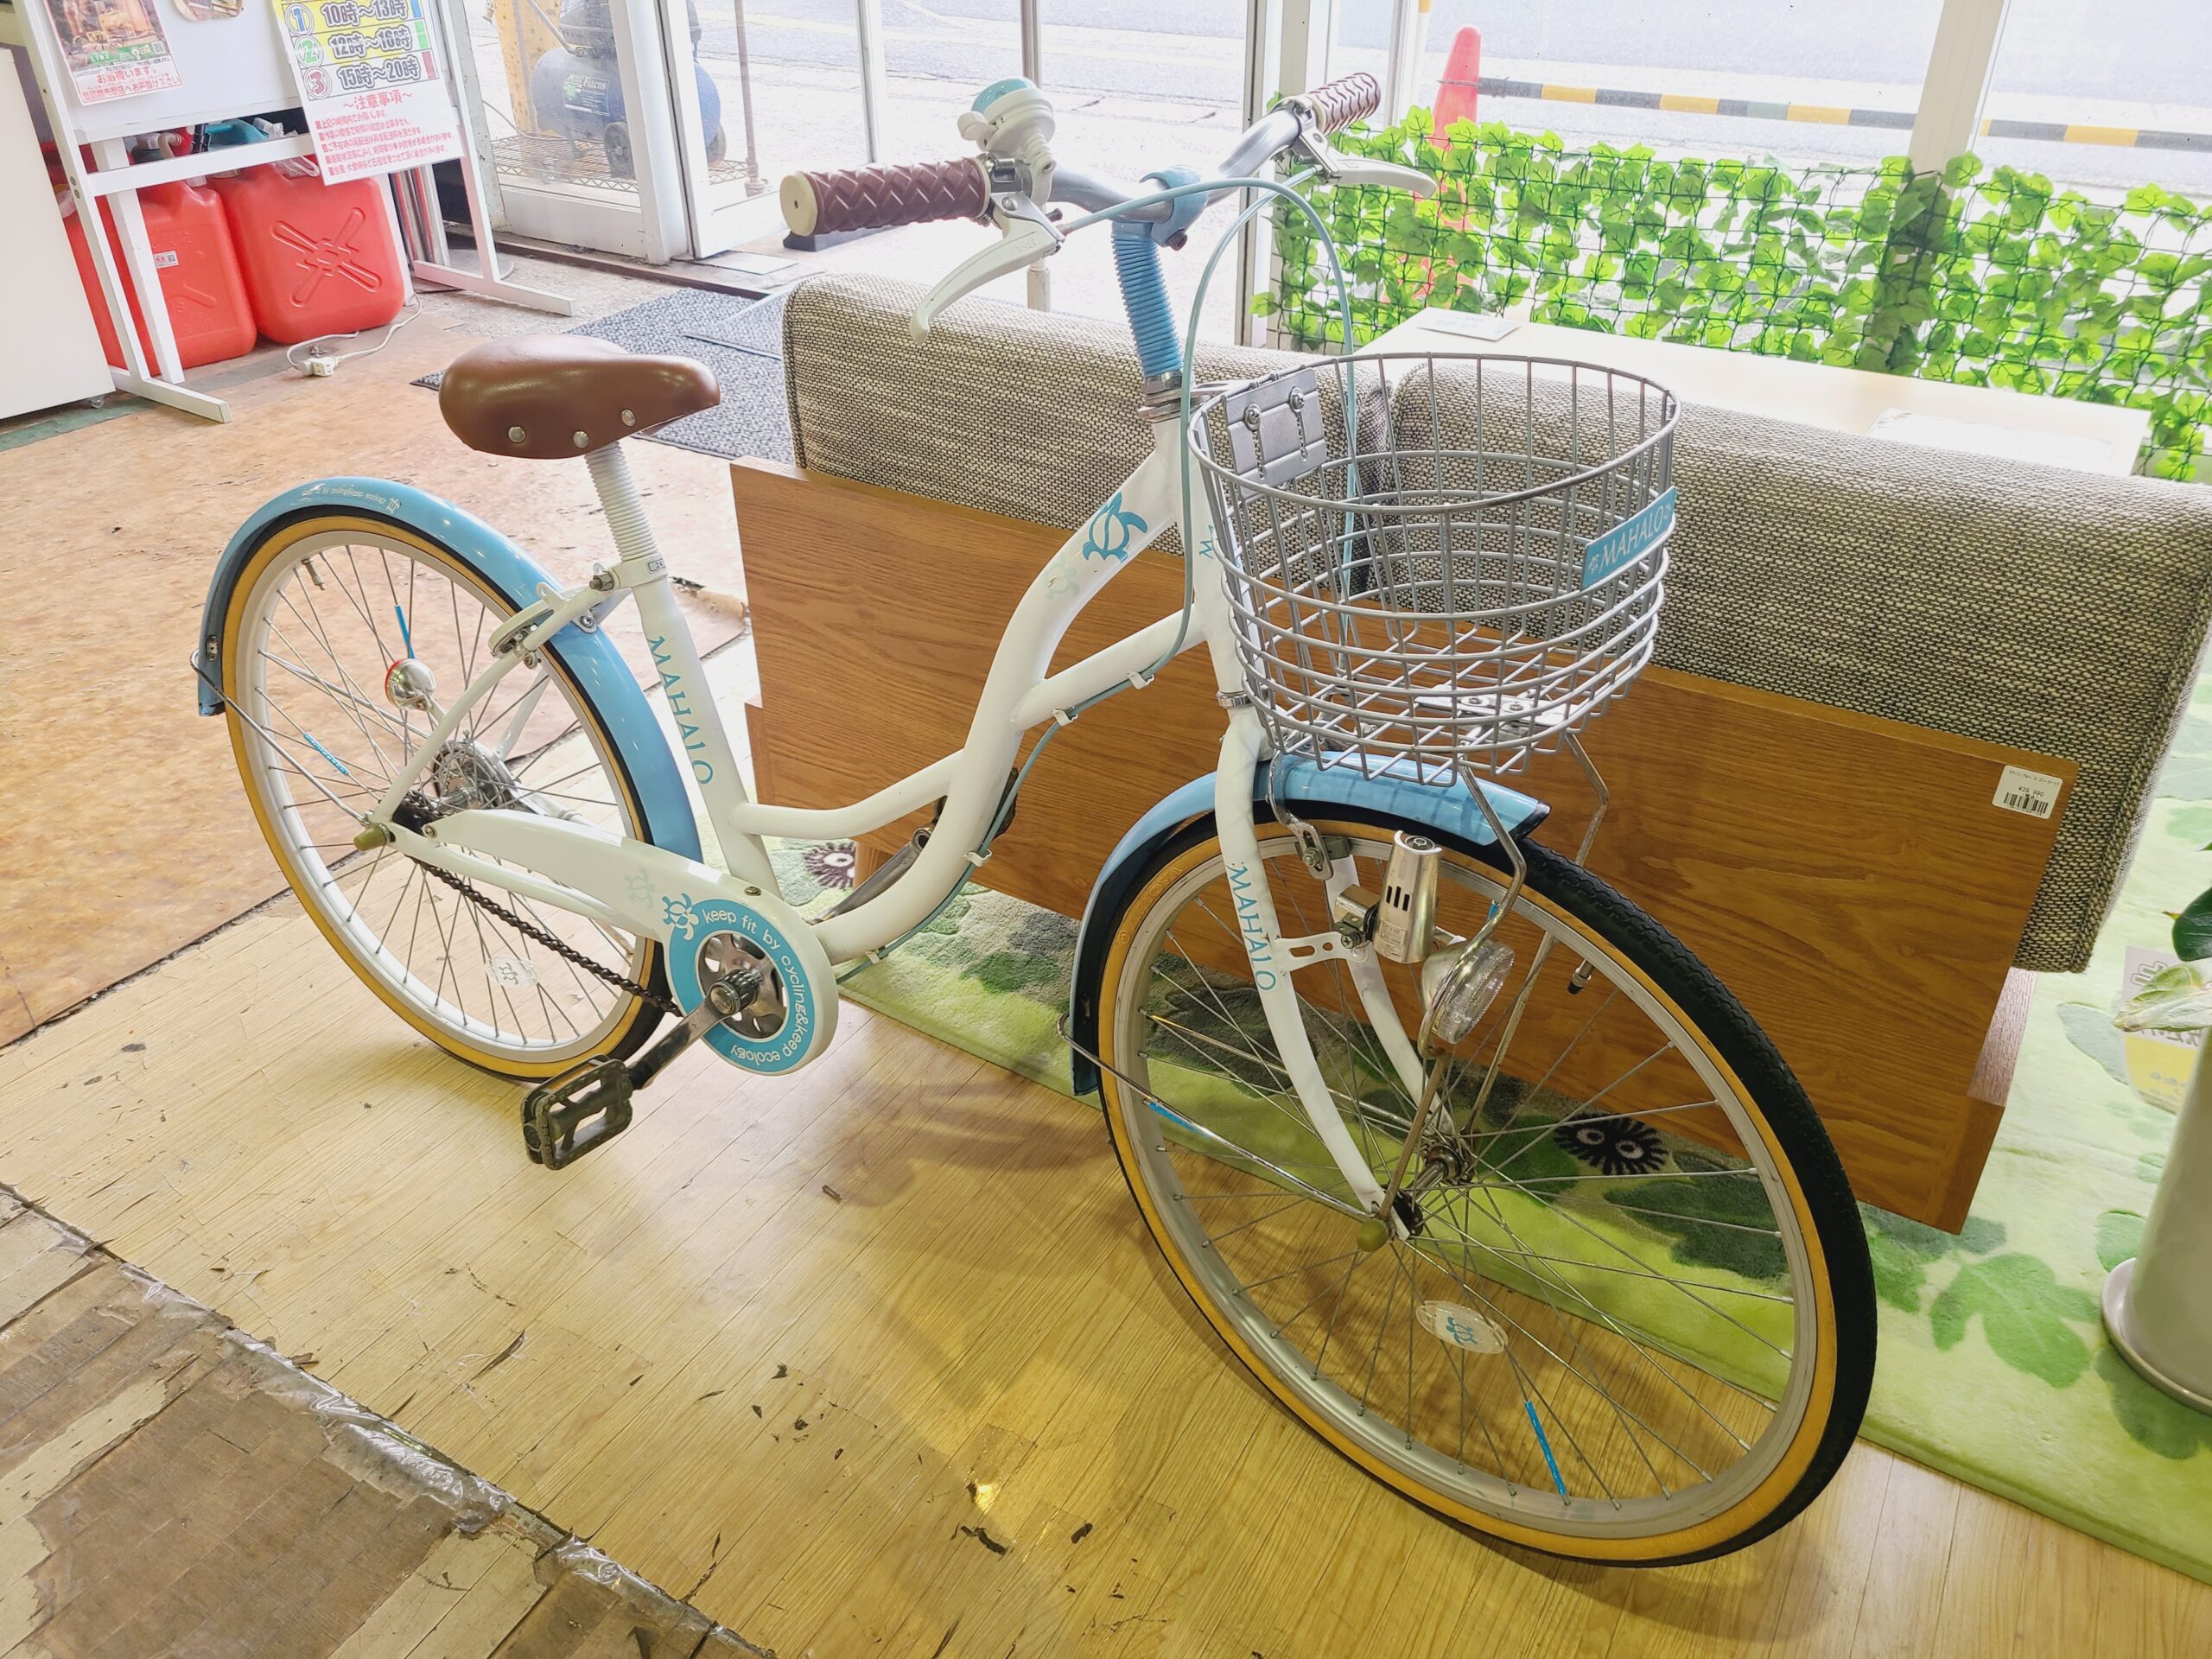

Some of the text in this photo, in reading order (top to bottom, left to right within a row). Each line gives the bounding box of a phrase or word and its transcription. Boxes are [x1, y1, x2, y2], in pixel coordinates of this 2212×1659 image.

[1599, 505, 1664, 575] MAHALO
[702, 909, 737, 924] keep
[741, 915, 759, 935] fit
[1225, 866, 1277, 991] MAHALO
[763, 929, 780, 950] by
[730, 1044, 781, 1065] ecology
